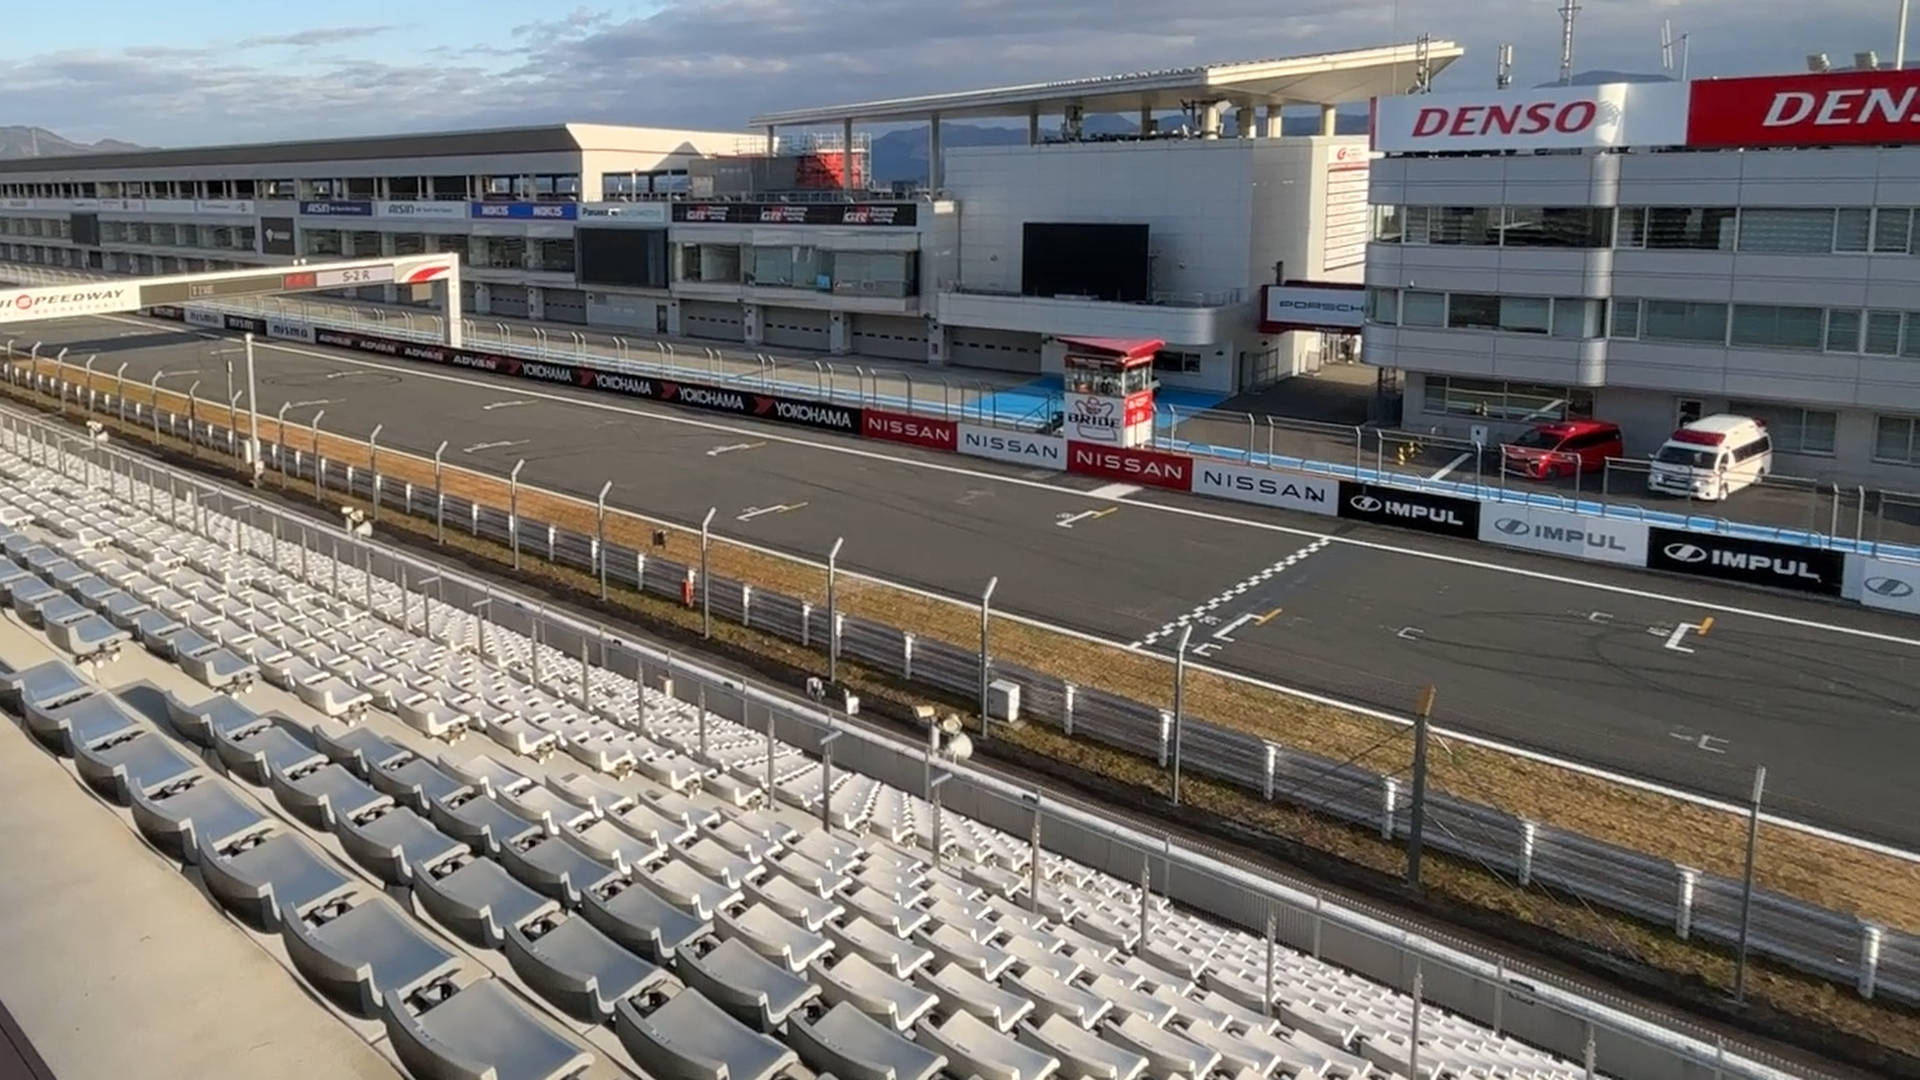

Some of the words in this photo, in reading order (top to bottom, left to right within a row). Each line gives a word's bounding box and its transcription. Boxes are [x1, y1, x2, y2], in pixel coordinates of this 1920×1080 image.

[1412, 100, 1597, 138] DENSO
[1279, 300, 1365, 313] PORSCH
[273, 324, 308, 339] nismo
[360, 340, 396, 354] ADVAN
[404, 347, 444, 362] ADVAN
[453, 355, 497, 370] ADVAN
[522, 363, 573, 382] YOKOHAMA
[594, 373, 653, 396] YOKOHAMA
[679, 386, 745, 410] YOKOHAMA
[775, 402, 853, 429] YOKOHAMA
[867, 417, 950, 443] NISSAN
[965, 432, 1059, 461] NISSAN
[1075, 449, 1184, 481] NISSAN
[1203, 470, 1326, 504] NISSAN
[1384, 500, 1464, 526] IMPUL
[1534, 524, 1626, 552] IMPUL
[1711, 549, 1821, 583] IMPUL
